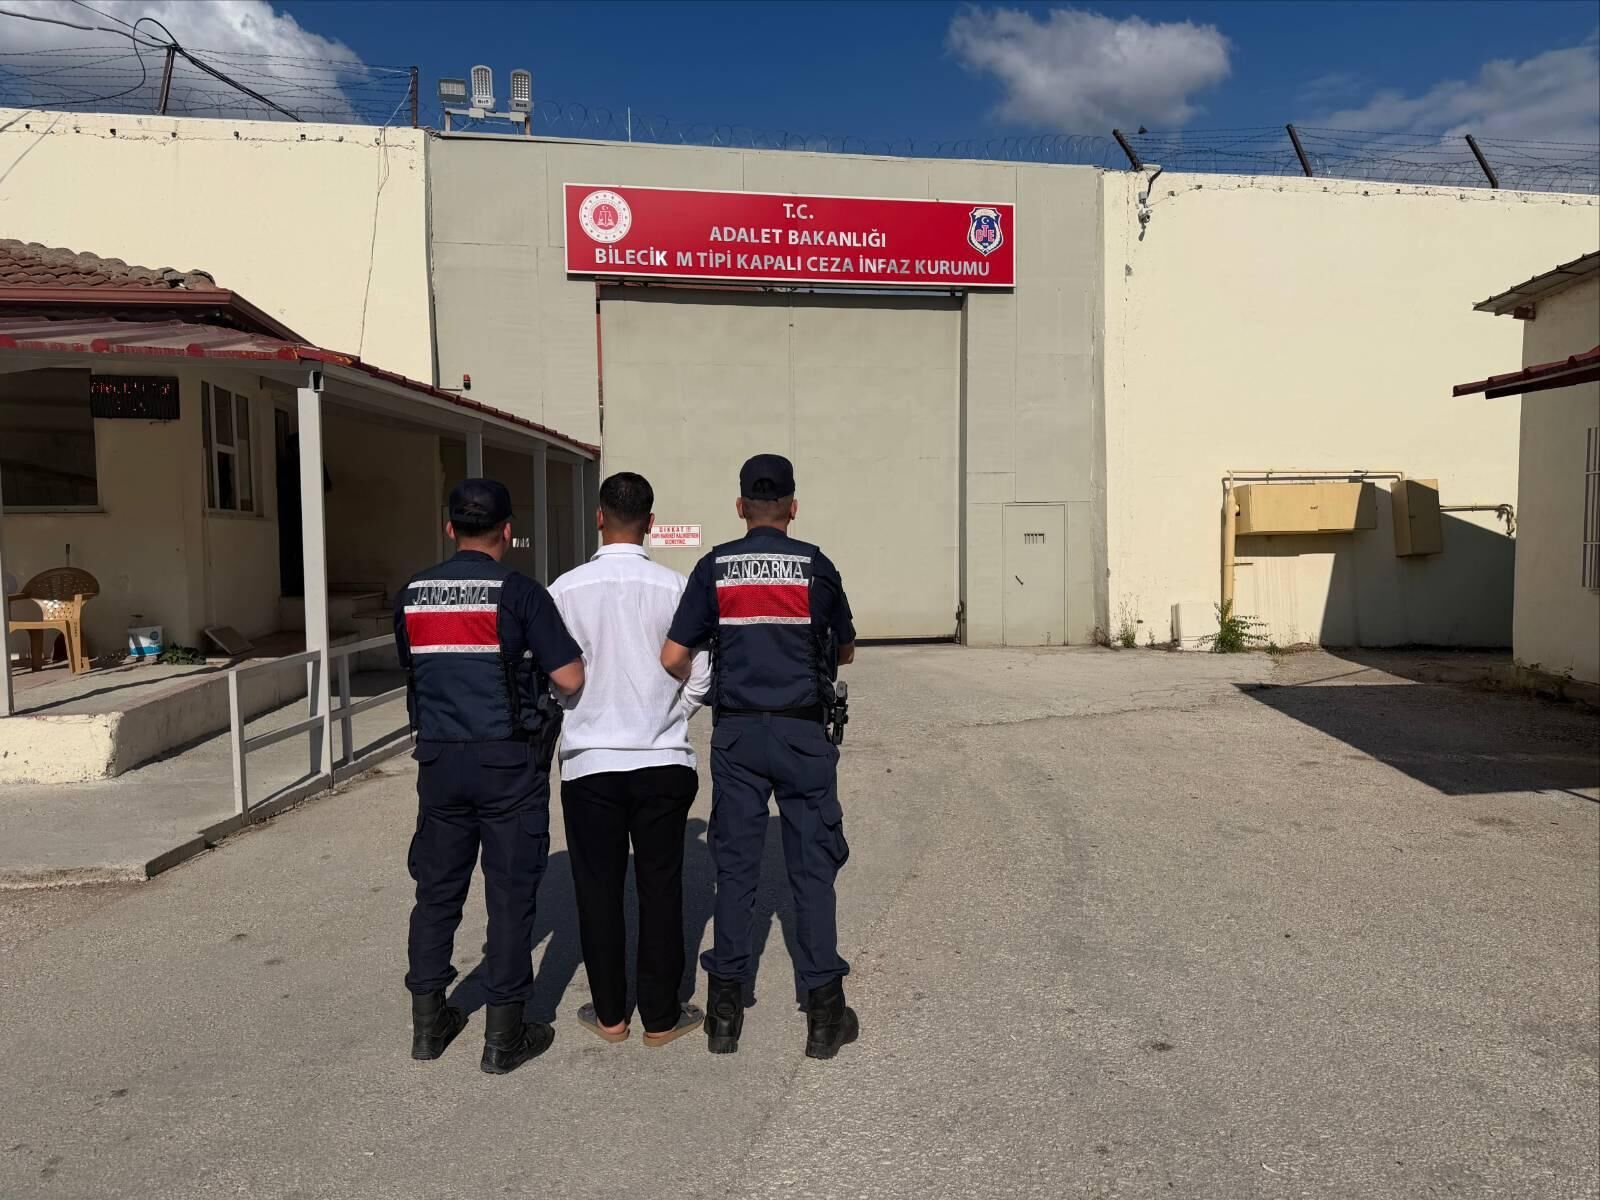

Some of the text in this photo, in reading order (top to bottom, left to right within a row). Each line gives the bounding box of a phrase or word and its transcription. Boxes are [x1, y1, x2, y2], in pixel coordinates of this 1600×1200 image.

[783, 203, 814, 219] T.C.
[709, 226, 886, 247] ADALET BAKANLIĞI
[595, 245, 990, 276] BİLECİK M TİPİ KAPALI CEZA İNFAZ KURUMU
[723, 560, 804, 580] JANDARMA
[412, 586, 489, 605] JANDARMA
